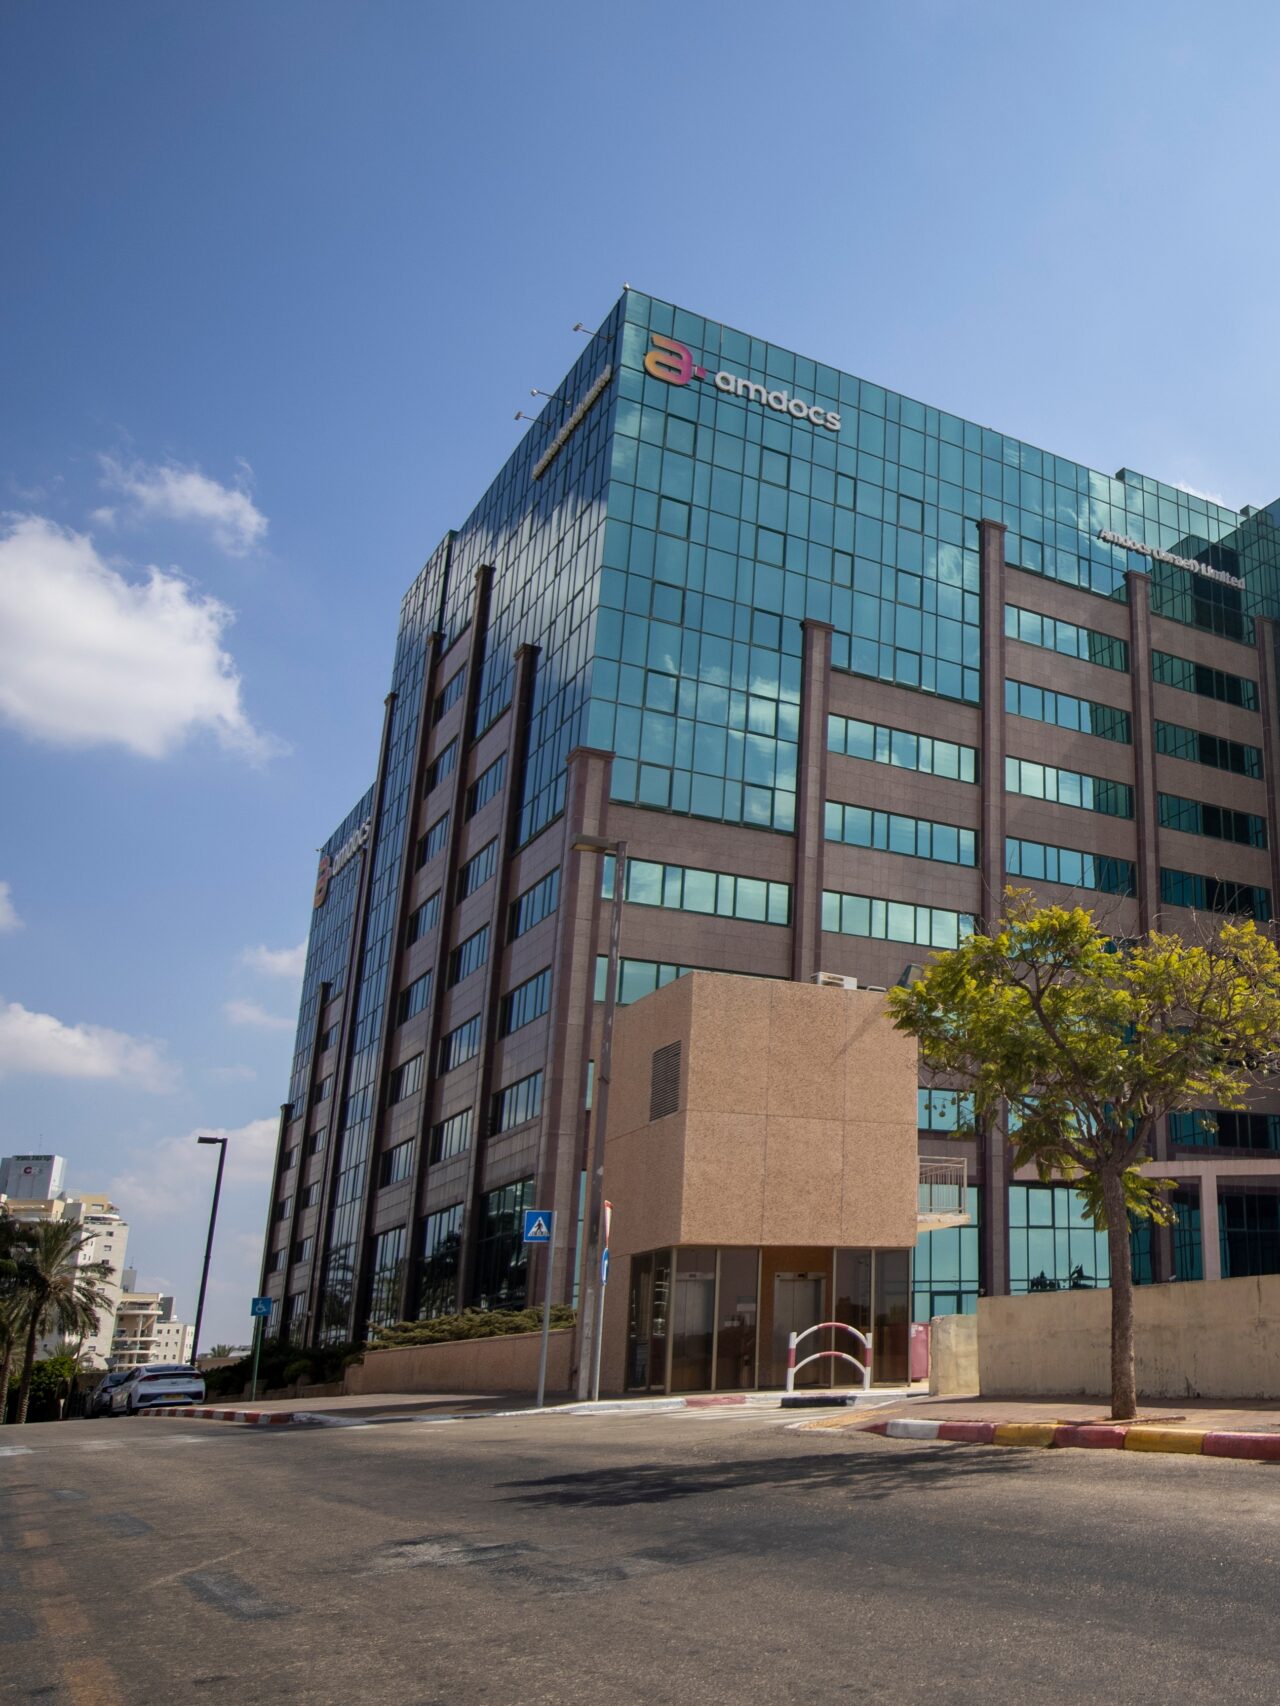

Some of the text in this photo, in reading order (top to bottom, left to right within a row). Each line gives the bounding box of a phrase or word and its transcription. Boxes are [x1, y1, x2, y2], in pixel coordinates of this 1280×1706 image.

[714, 370, 842, 432] amdocs
[1152, 547, 1200, 573] (Israel)
[1200, 562, 1246, 590] Limited
